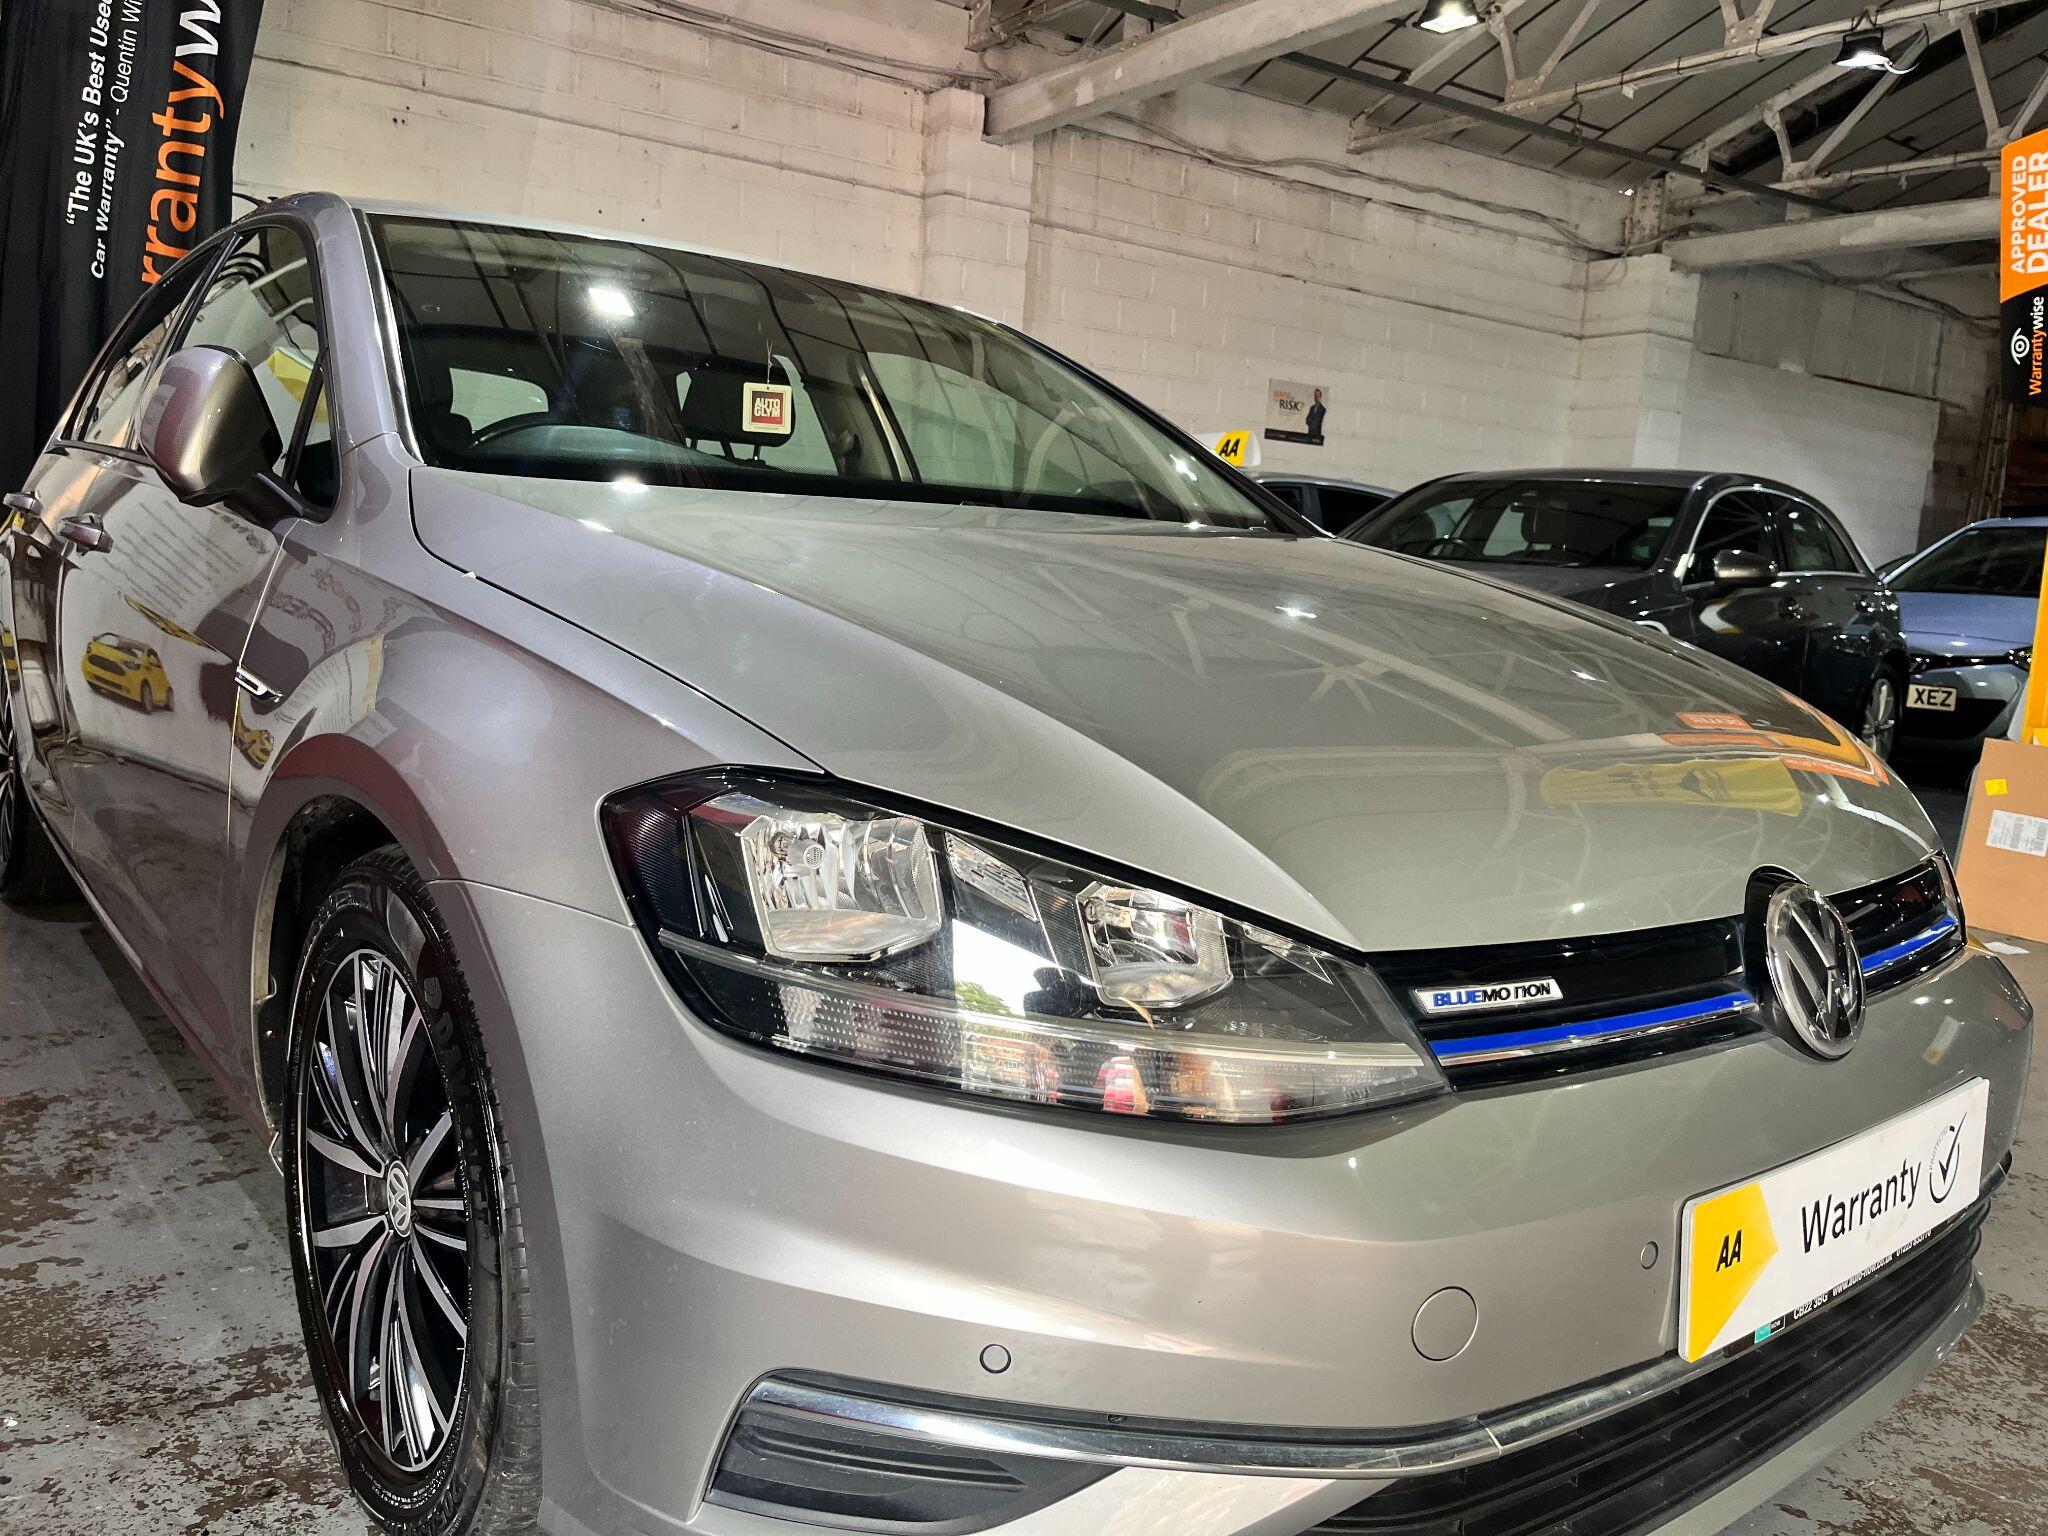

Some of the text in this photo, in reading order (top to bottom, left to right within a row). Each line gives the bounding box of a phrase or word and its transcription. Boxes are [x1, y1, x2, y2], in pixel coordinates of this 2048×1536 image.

[121, 0, 143, 22] Wi
[82, 52, 106, 105] Best
[110, 29, 138, 103] Quentin
[74, 110, 99, 165] UK’s
[66, 172, 93, 225] “The
[2011, 155, 2026, 274] APPROVED
[2027, 151, 2048, 274] DEALER
[91, 238, 107, 279] Car
[2028, 297, 2047, 396] Warrantywise
[754, 405, 781, 417] GLYM
[755, 398, 781, 408] AUTO
[1219, 438, 1241, 457] AA
[1914, 688, 1953, 707] XEZ
[1433, 982, 1551, 1007] BLUEMOTION
[1715, 1158, 1922, 1272] AA Warranty
